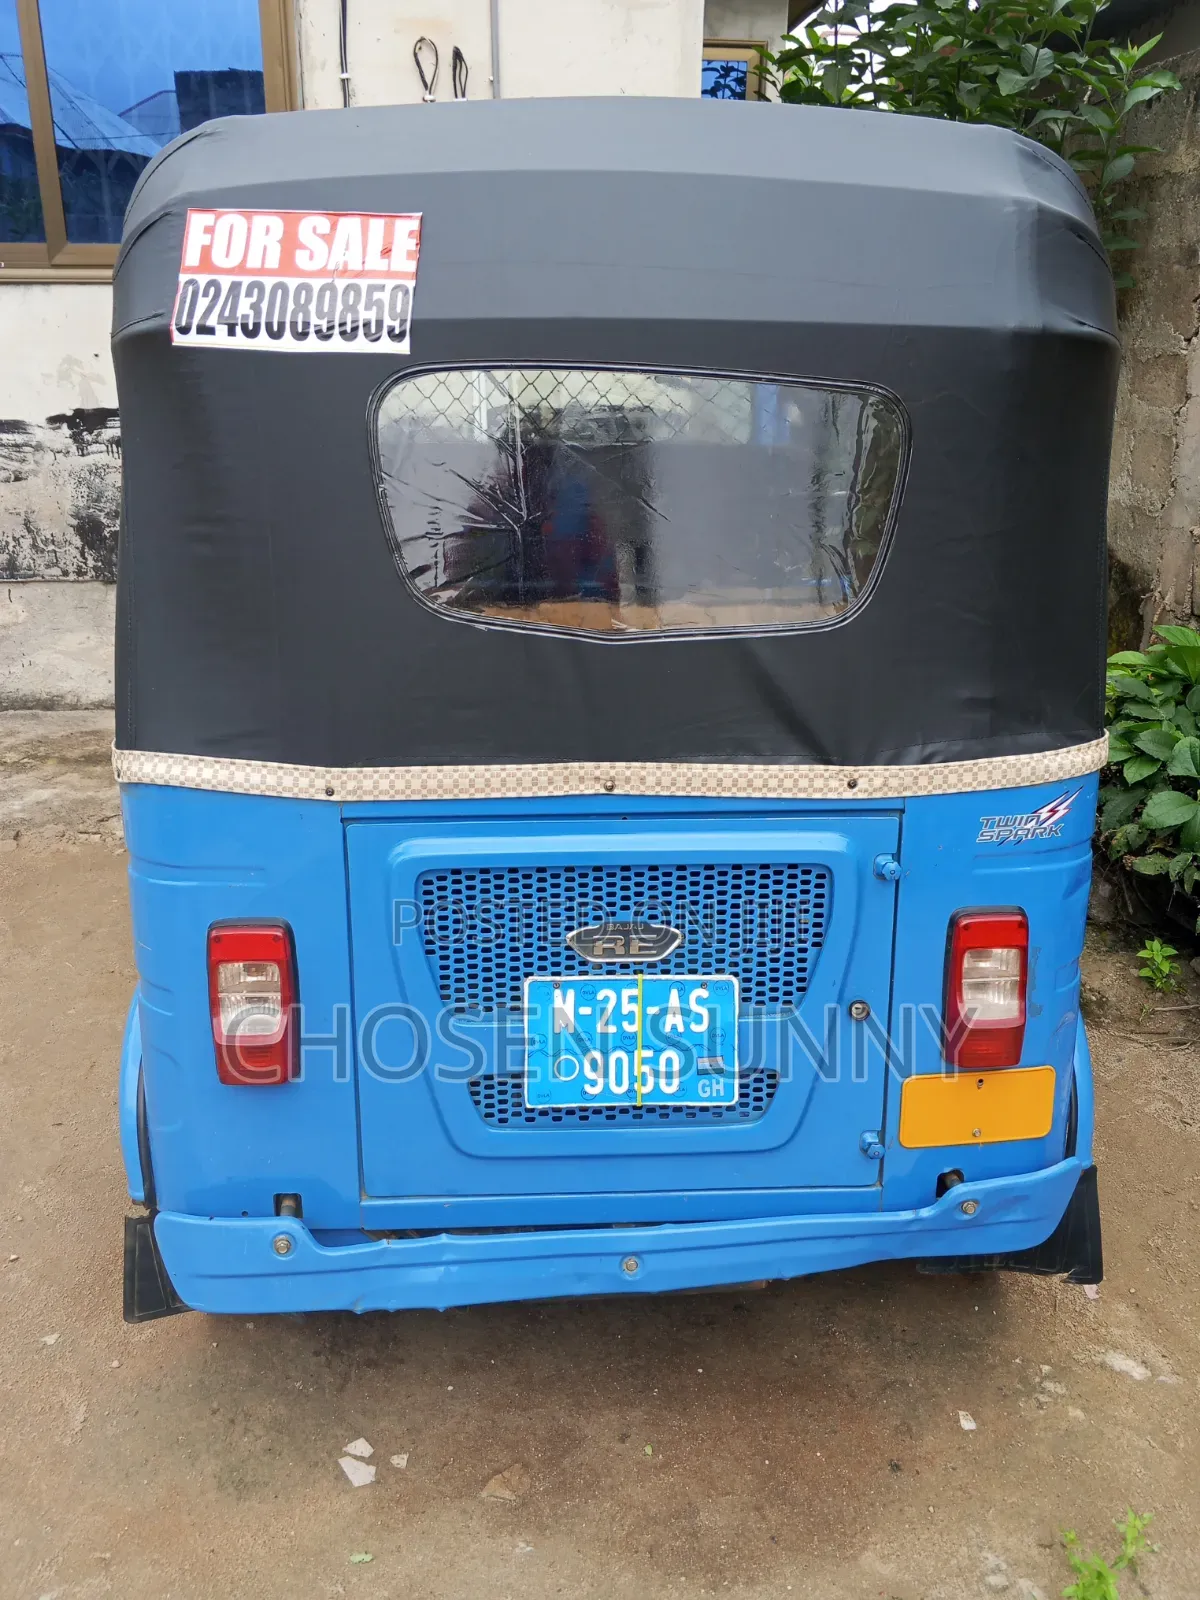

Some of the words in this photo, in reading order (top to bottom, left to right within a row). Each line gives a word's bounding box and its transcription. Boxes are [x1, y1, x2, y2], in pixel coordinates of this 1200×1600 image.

[184, 213, 284, 268] FOR
[294, 216, 420, 272] SALE
[175, 278, 410, 343] 0243089859
[979, 814, 1041, 829] TWIN
[976, 823, 1064, 842] SPARK
[606, 923, 645, 931] BAJAJ
[593, 934, 657, 955] RE
[553, 988, 710, 1033] M-25-AS
[583, 1050, 680, 1095] 9050
[697, 1078, 725, 1098] GH
